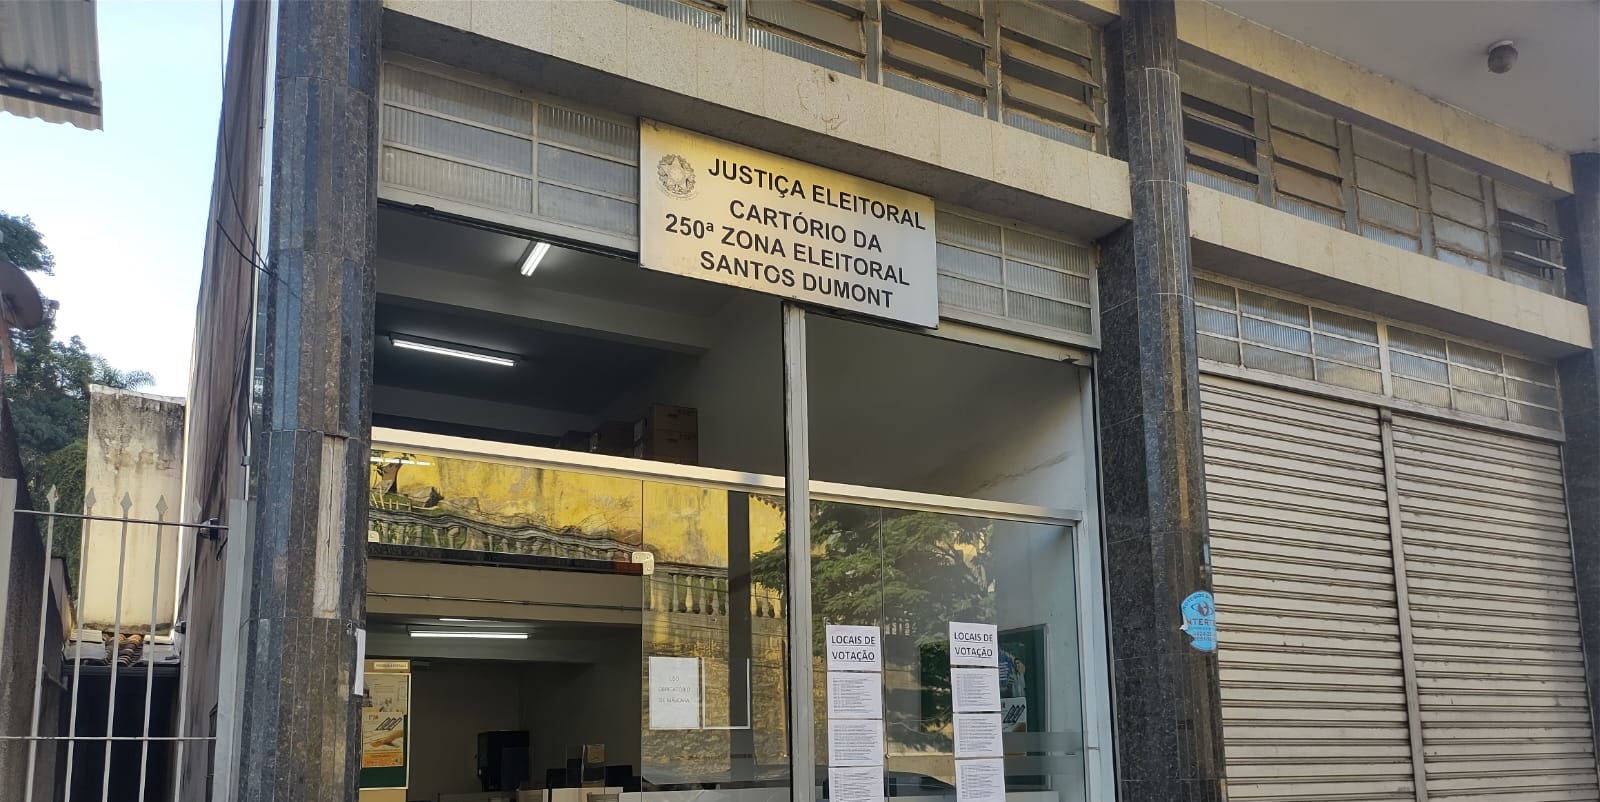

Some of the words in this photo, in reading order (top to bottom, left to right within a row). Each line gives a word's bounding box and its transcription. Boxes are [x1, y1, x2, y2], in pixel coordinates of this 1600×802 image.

[708, 158, 806, 199] JUSTIÇA
[812, 184, 926, 230] ELEITORAL
[729, 200, 847, 244] CARTÓRIO
[853, 231, 883, 253] DA
[721, 226, 786, 258] ZONA
[793, 243, 910, 286] ELEITORAL
[700, 251, 796, 287] SANTOS
[803, 272, 893, 309] DUMONT
[831, 635, 862, 645] LOCAIS
[864, 636, 876, 645] DE
[954, 632, 982, 642] LOCAIS
[984, 633, 993, 642] DE
[955, 646, 993, 657] VOTAÇÃO
[832, 650, 875, 661] VOTAÇÃO
